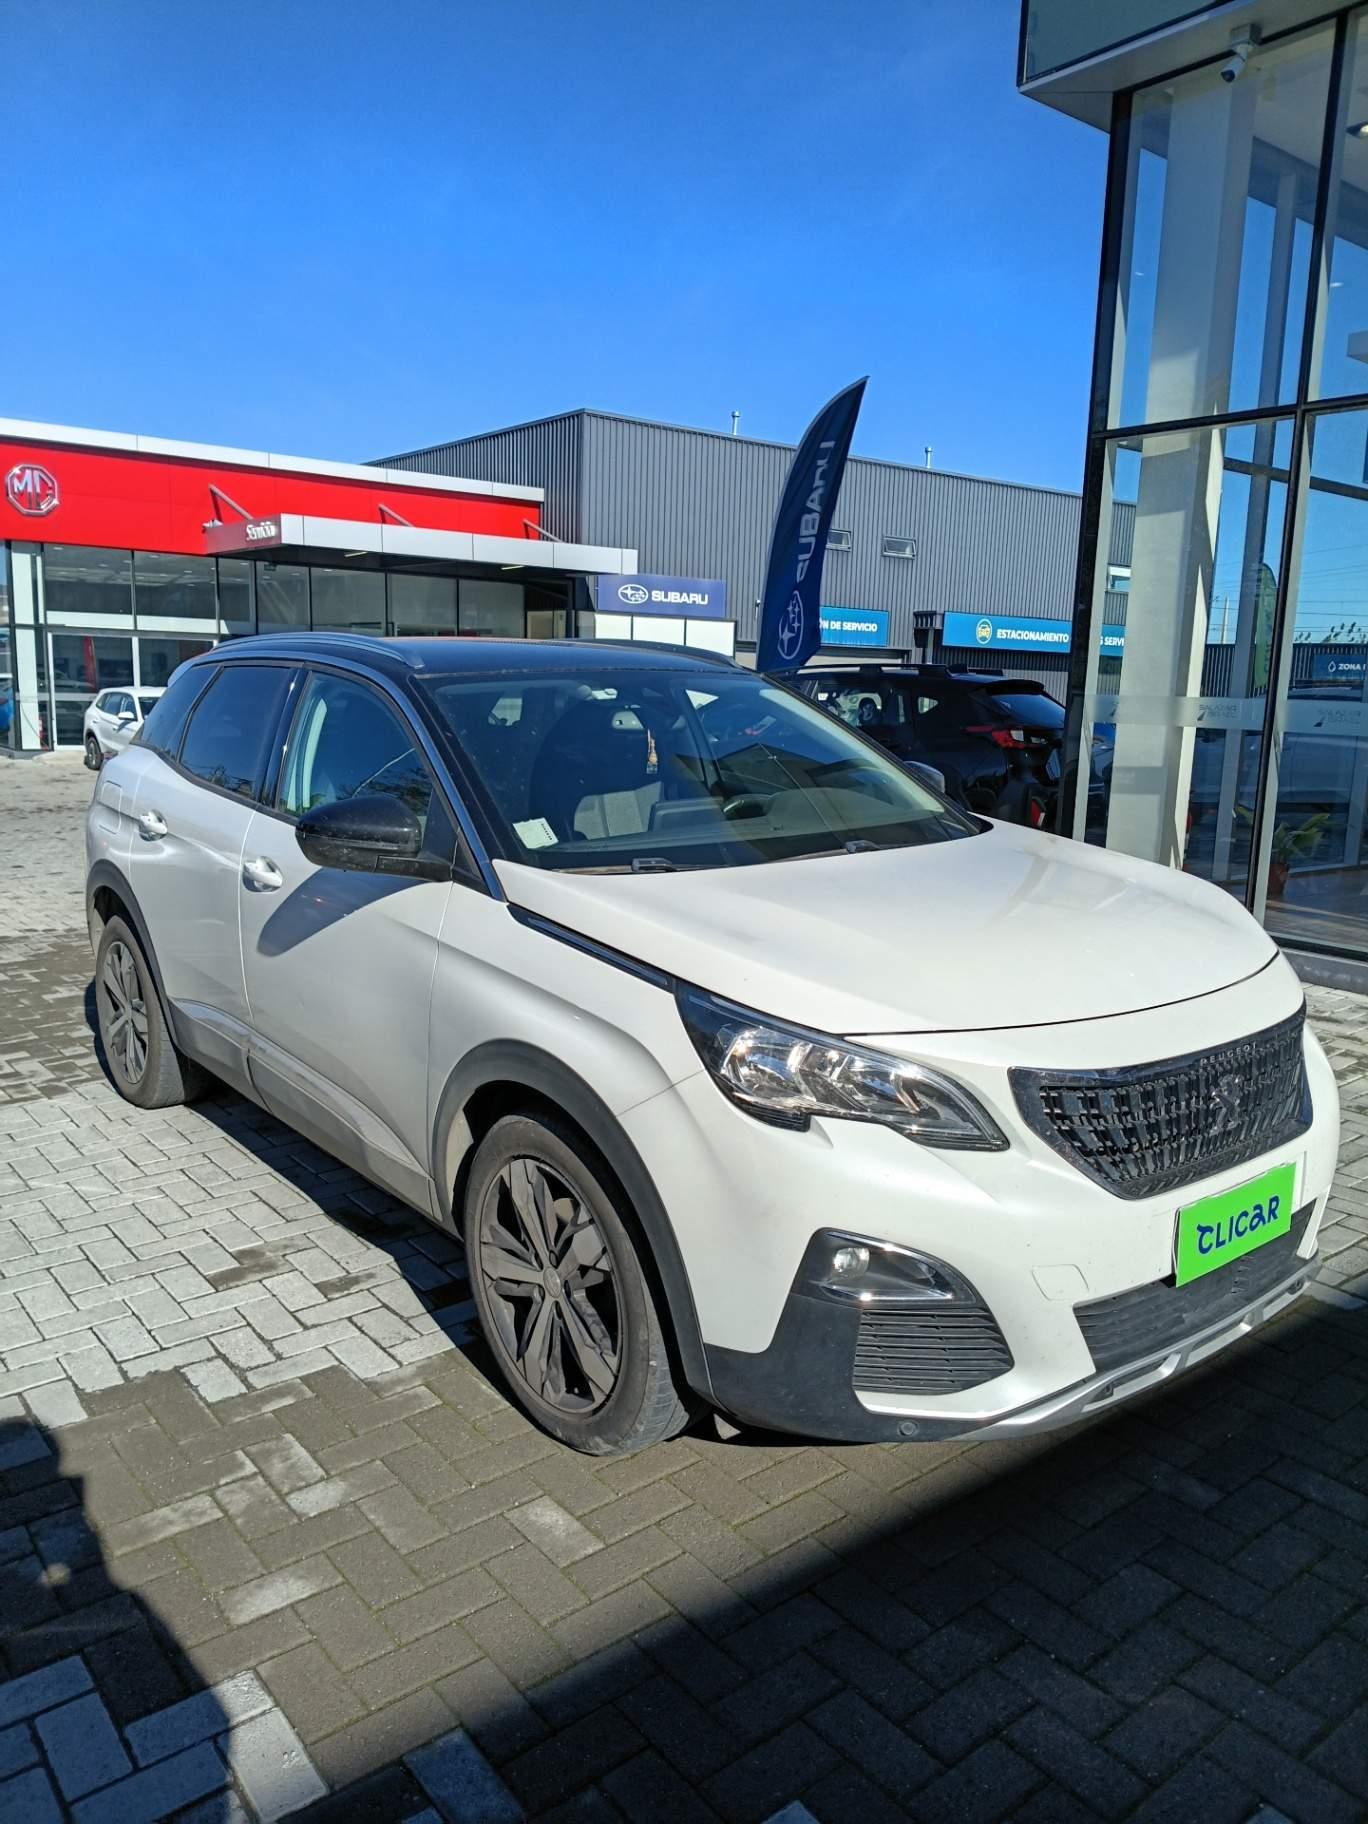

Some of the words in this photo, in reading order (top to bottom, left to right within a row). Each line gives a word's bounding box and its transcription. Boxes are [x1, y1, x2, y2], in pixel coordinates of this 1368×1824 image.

[12, 468, 54, 510] MG
[651, 589, 709, 605] SUBARU
[830, 620, 842, 630] DE
[842, 621, 878, 633] SERVICIO
[996, 628, 1070, 643] ESTACIONAMIENTO
[1103, 635, 1125, 647] SERVI
[1337, 663, 1361, 671] ZONA
[1199, 1041, 1257, 1067] PEUGEOT
